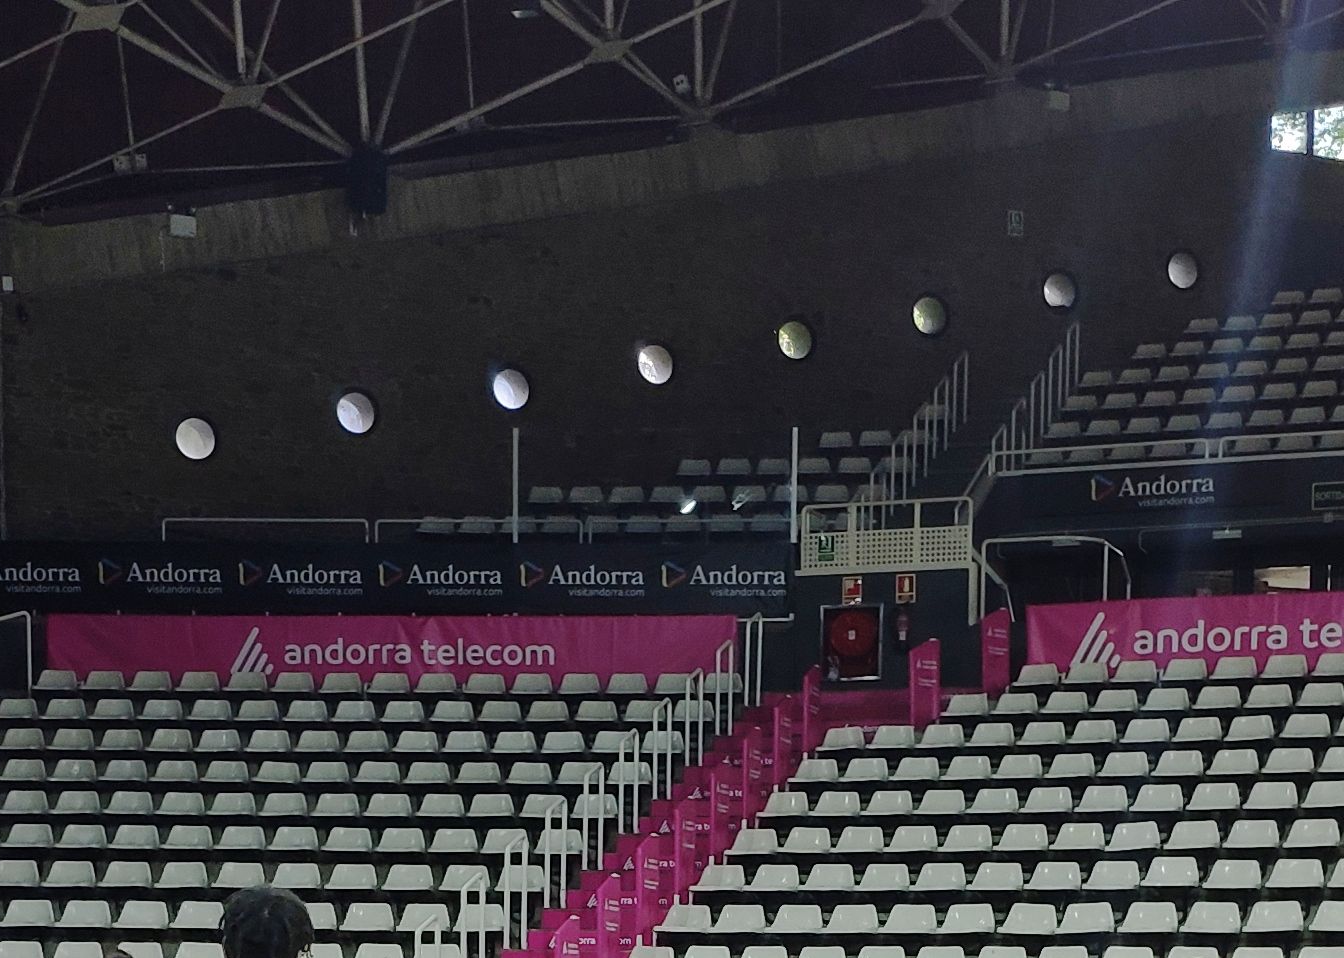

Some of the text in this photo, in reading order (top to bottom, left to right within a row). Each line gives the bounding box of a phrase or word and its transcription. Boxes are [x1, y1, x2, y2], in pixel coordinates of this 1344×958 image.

[1117, 474, 1215, 497] Andorra
[127, 562, 222, 584] Andorra
[267, 563, 362, 585] Andorra
[407, 564, 503, 586] Andorra
[548, 565, 644, 586] Andorra
[689, 565, 786, 587] Andorra
[1133, 622, 1289, 655] andorra
[284, 640, 555, 666] andorra telecom
